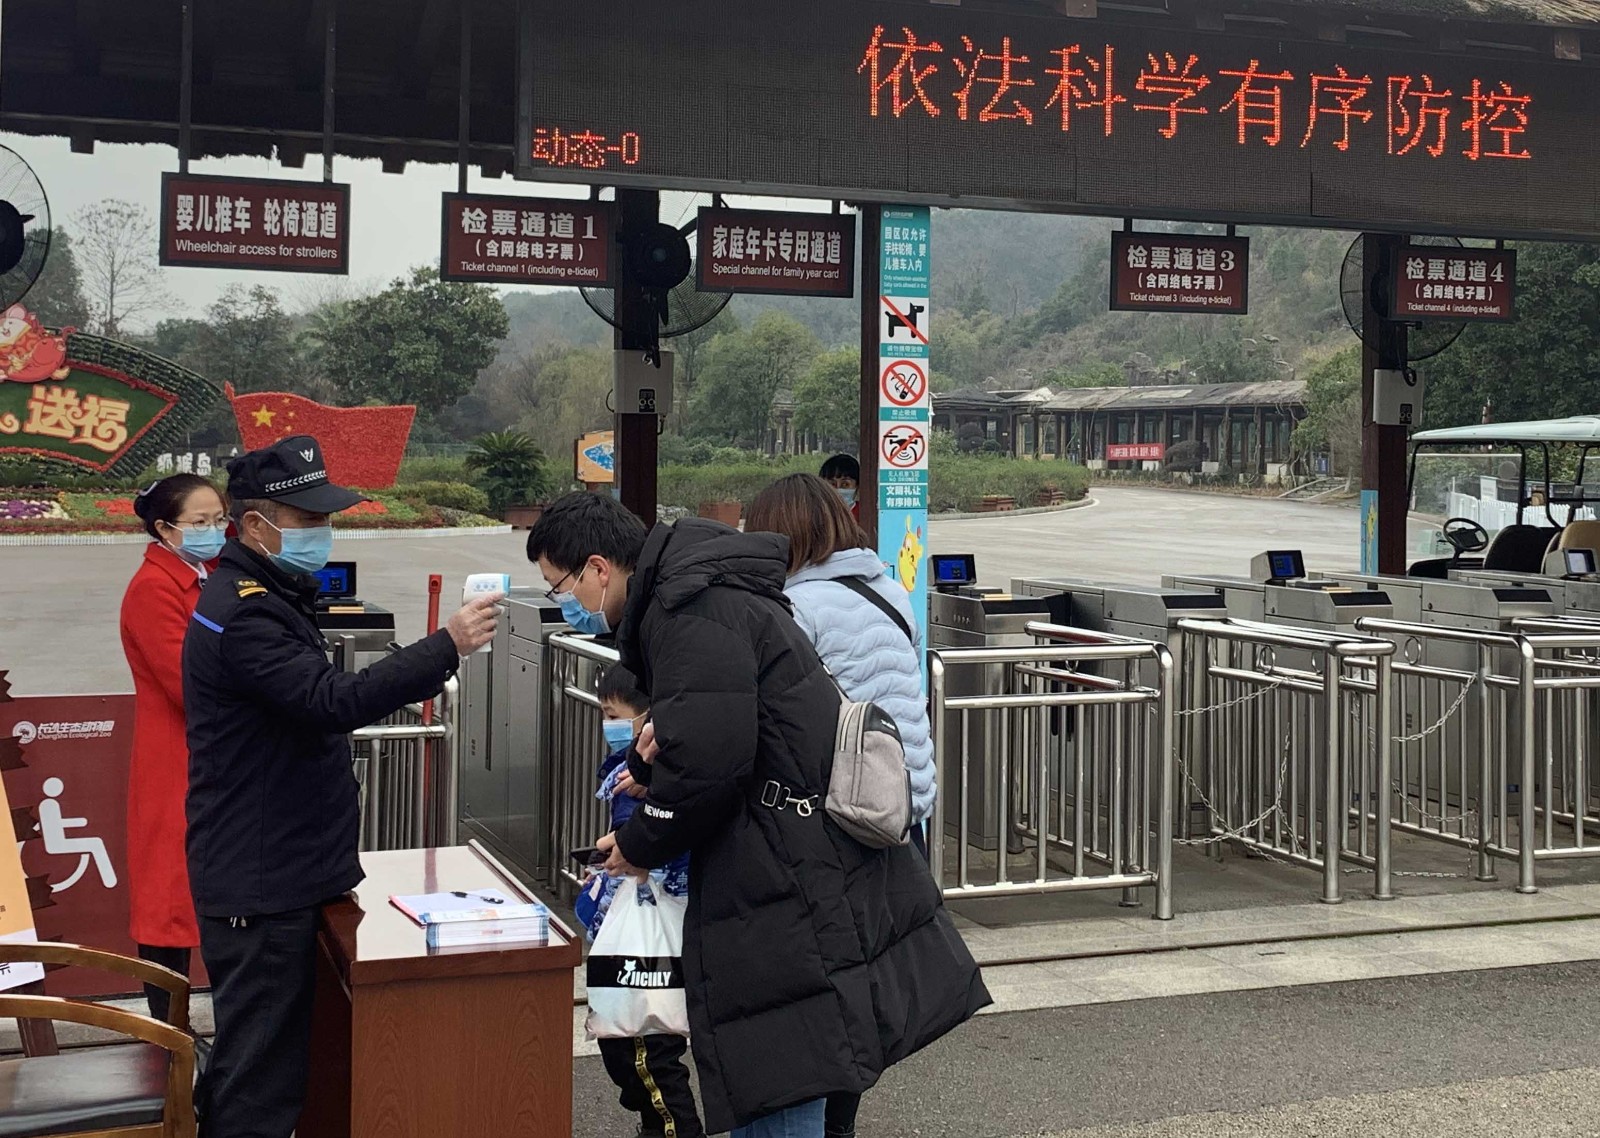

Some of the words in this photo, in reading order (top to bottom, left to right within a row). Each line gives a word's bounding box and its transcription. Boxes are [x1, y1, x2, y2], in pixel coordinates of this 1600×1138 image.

[858, 25, 1531, 160] 依法科学有序防控
[176, 194, 251, 234] 婴儿推车
[264, 198, 336, 238] 轮椅通道
[461, 207, 598, 240] 检票通道1
[176, 239, 236, 253] Wheelchair
[239, 244, 276, 256] access
[279, 244, 293, 256] for
[296, 246, 338, 259] strollers
[712, 225, 841, 264] 家庭年卡专用通道
[461, 261, 485, 272] Ticket
[486, 262, 518, 273] channel
[521, 264, 526, 273] 1
[528, 264, 566, 277] (including
[567, 266, 598, 278] e-ticket)
[1128, 245, 1235, 271] 检票通道3
[1406, 257, 1504, 282] 检票通道4
[712, 262, 740, 275] Special
[742, 264, 771, 276] channel
[772, 266, 782, 276] for
[784, 266, 804, 280] family
[806, 269, 822, 280] year
[824, 268, 839, 279] card
[1130, 292, 1147, 302] Ticket
[1148, 293, 1172, 302] channel
[1172, 294, 1177, 302] 3
[1180, 294, 1207, 305] (including
[1208, 296, 1232, 306] e-ticket)
[1407, 302, 1424, 311] Ticket
[1424, 303, 1446, 312] channel
[1452, 304, 1478, 314] (including
[1478, 306, 1500, 315] e-ticket)
[0, 384, 130, 453] 送福
